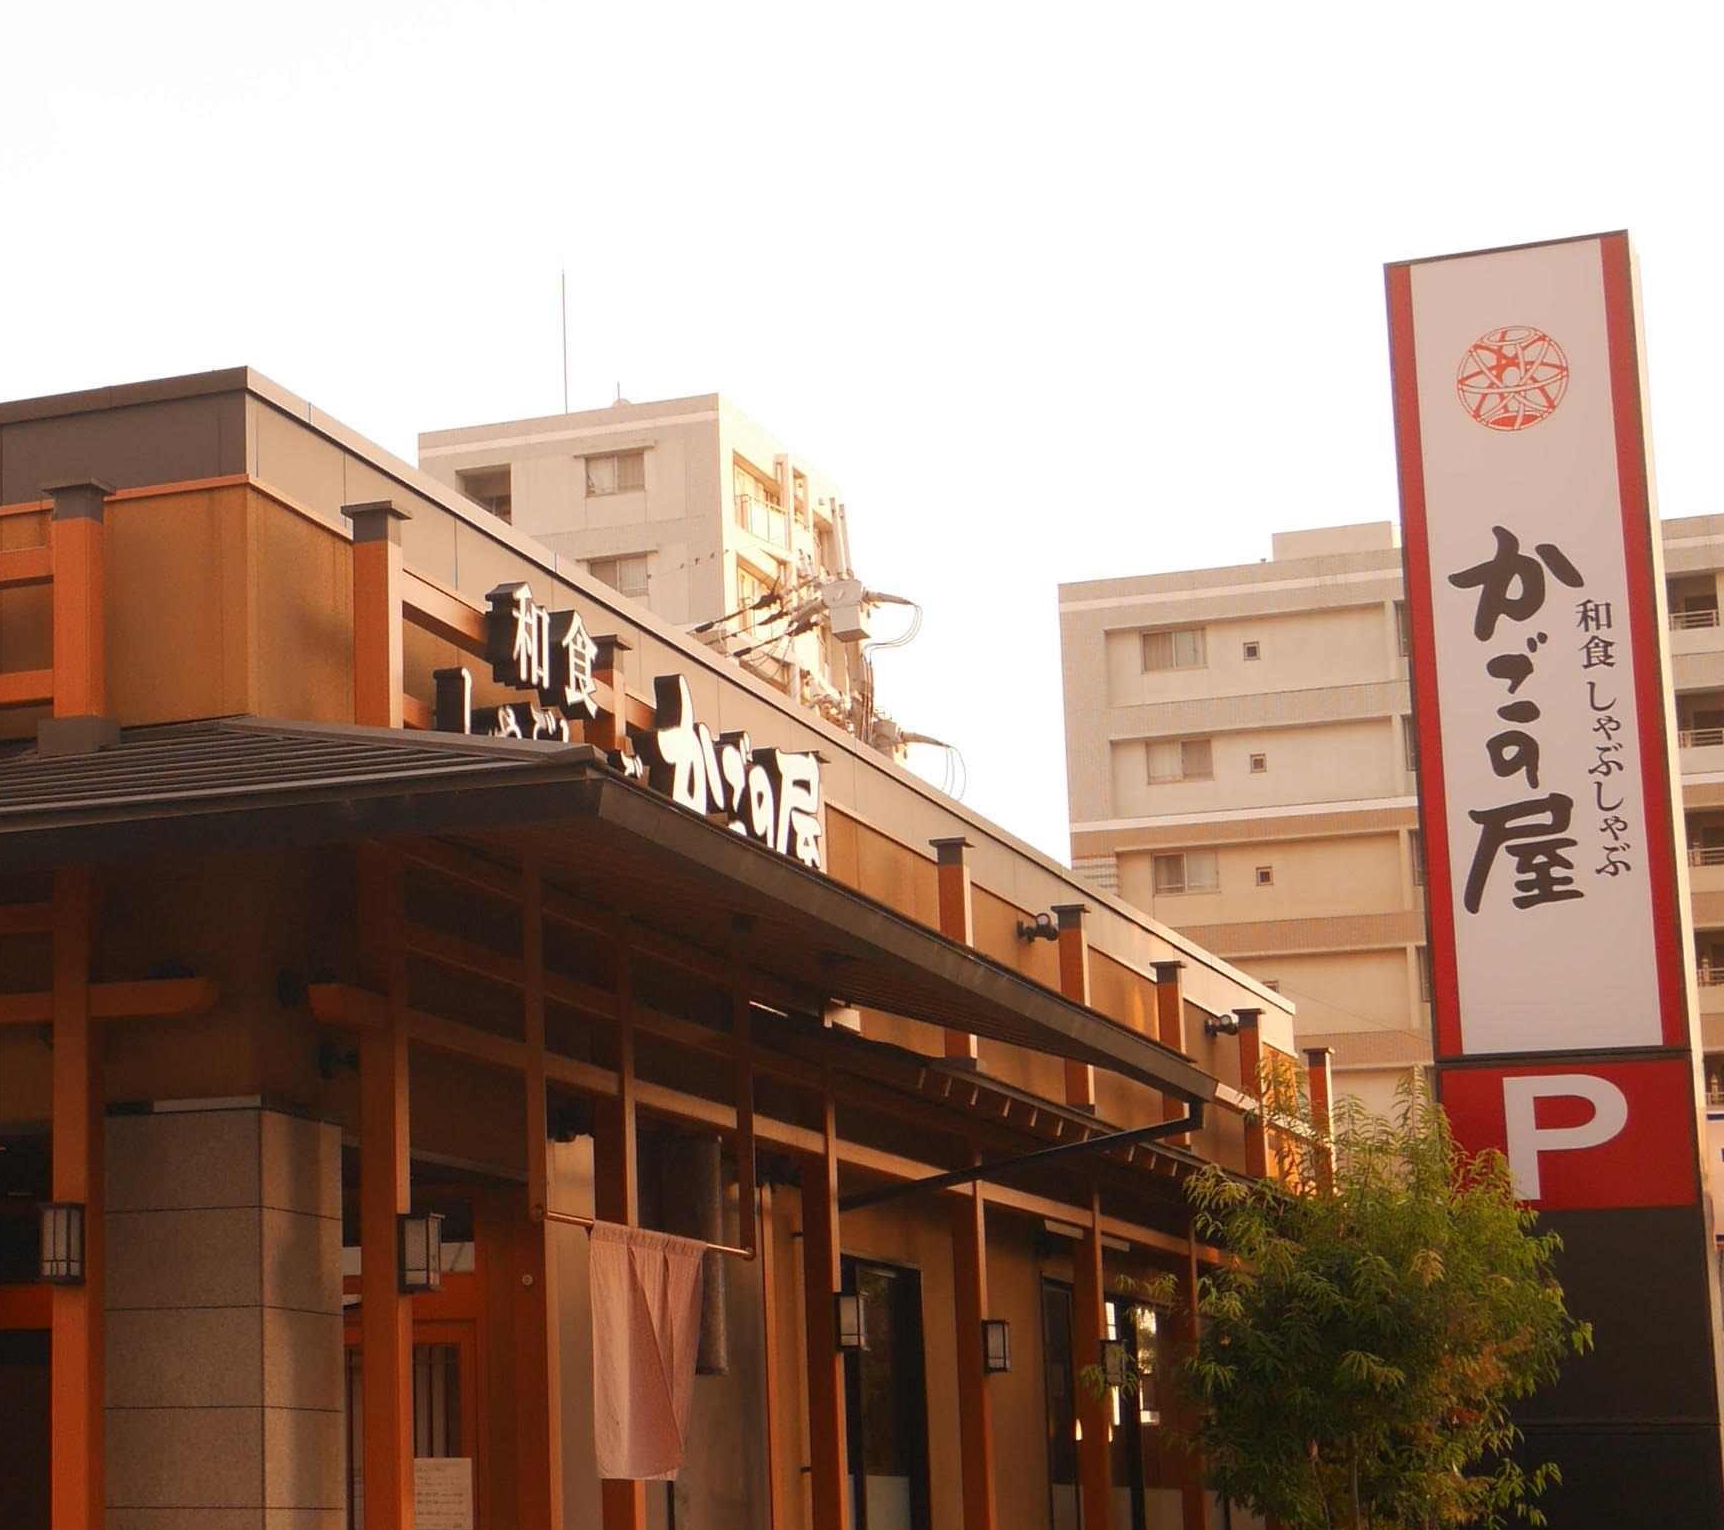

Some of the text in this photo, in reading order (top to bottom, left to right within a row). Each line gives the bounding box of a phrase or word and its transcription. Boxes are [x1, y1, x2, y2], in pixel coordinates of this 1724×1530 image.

[512, 581, 599, 719] 和食
[1447, 525, 1587, 915] かごの屋
[1503, 1074, 1630, 1201] P
